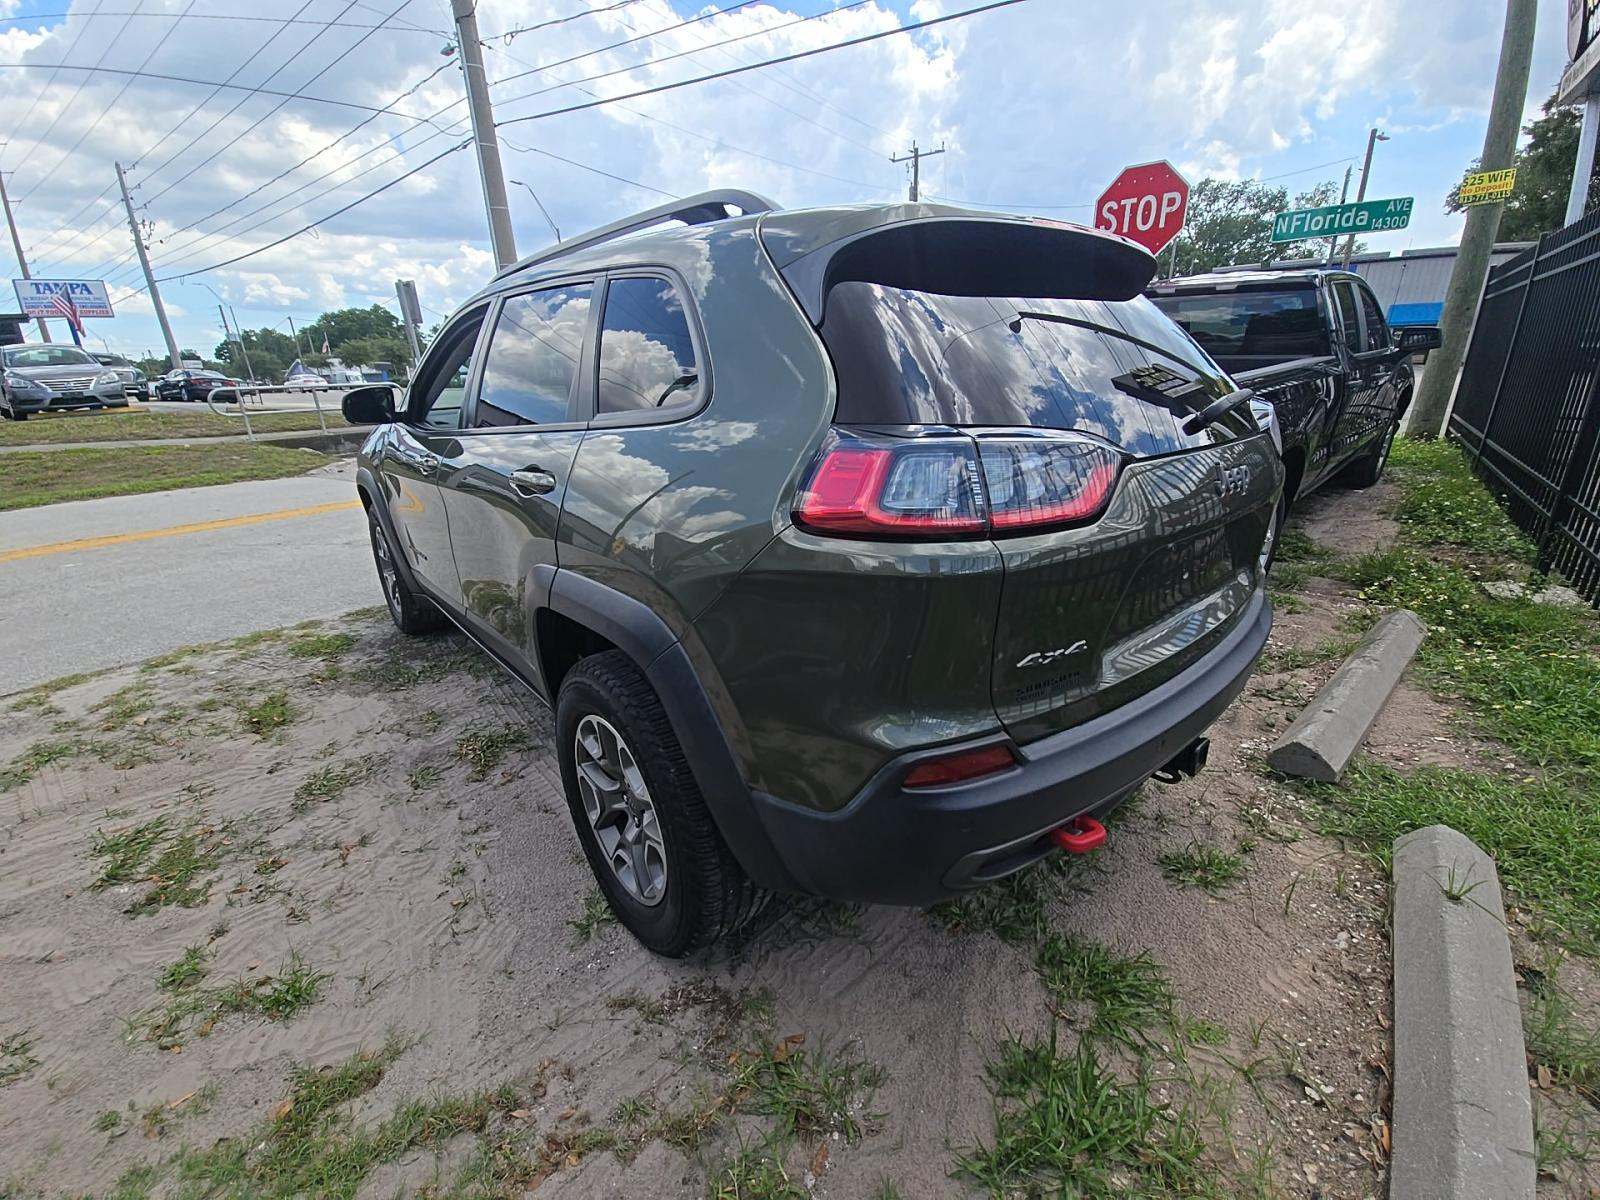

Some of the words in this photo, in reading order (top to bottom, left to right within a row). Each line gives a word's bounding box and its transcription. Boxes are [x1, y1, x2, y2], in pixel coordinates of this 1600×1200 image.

[1488, 169, 1515, 184] WiFi
[1461, 187, 1473, 196] No
[1101, 191, 1182, 234] STOP
[1386, 199, 1411, 213] AVE
[1371, 215, 1407, 230] 14300
[1215, 462, 1251, 497] Jeep
